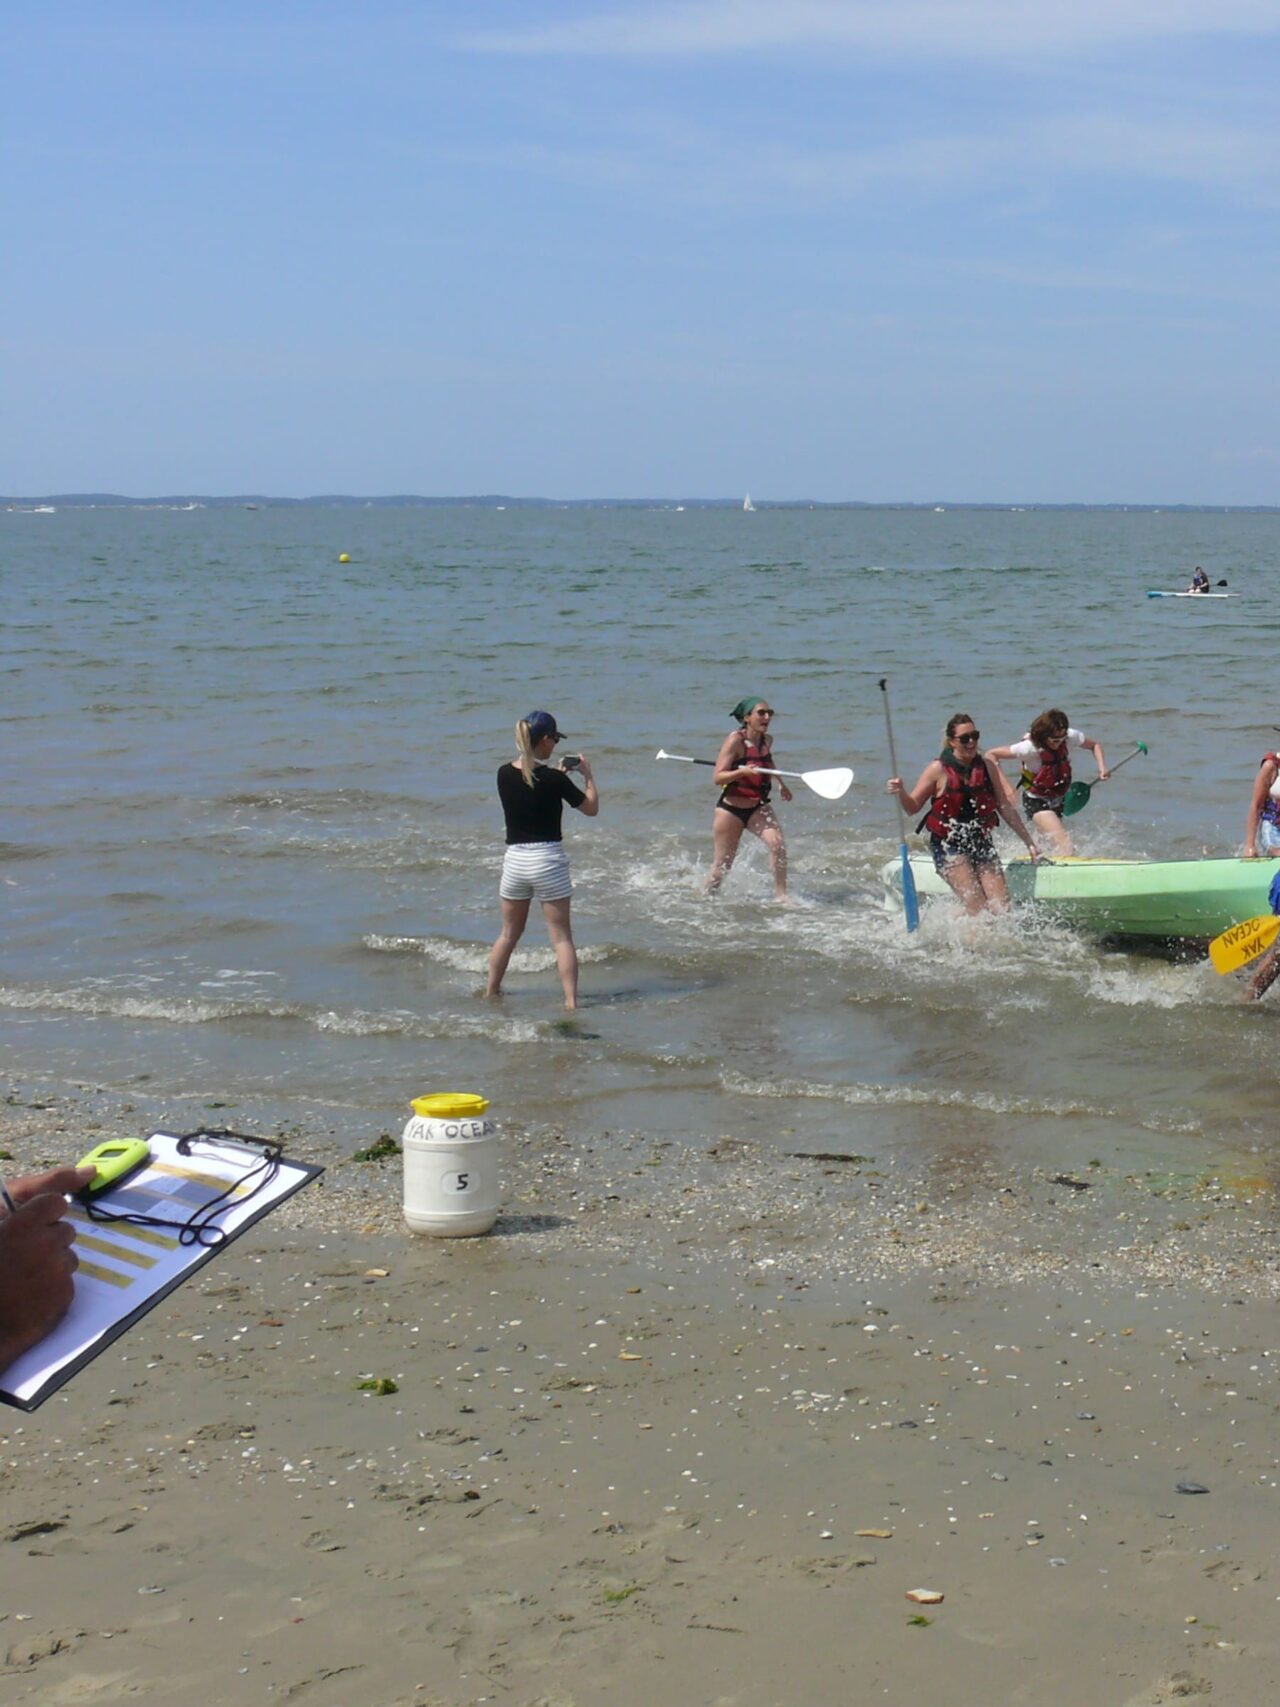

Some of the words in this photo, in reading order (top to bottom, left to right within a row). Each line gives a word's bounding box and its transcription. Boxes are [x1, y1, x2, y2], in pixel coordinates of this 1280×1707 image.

[1222, 918, 1261, 949] OCEAN
[1241, 936, 1265, 960] YAK
[456, 1173, 469, 1191] 5
